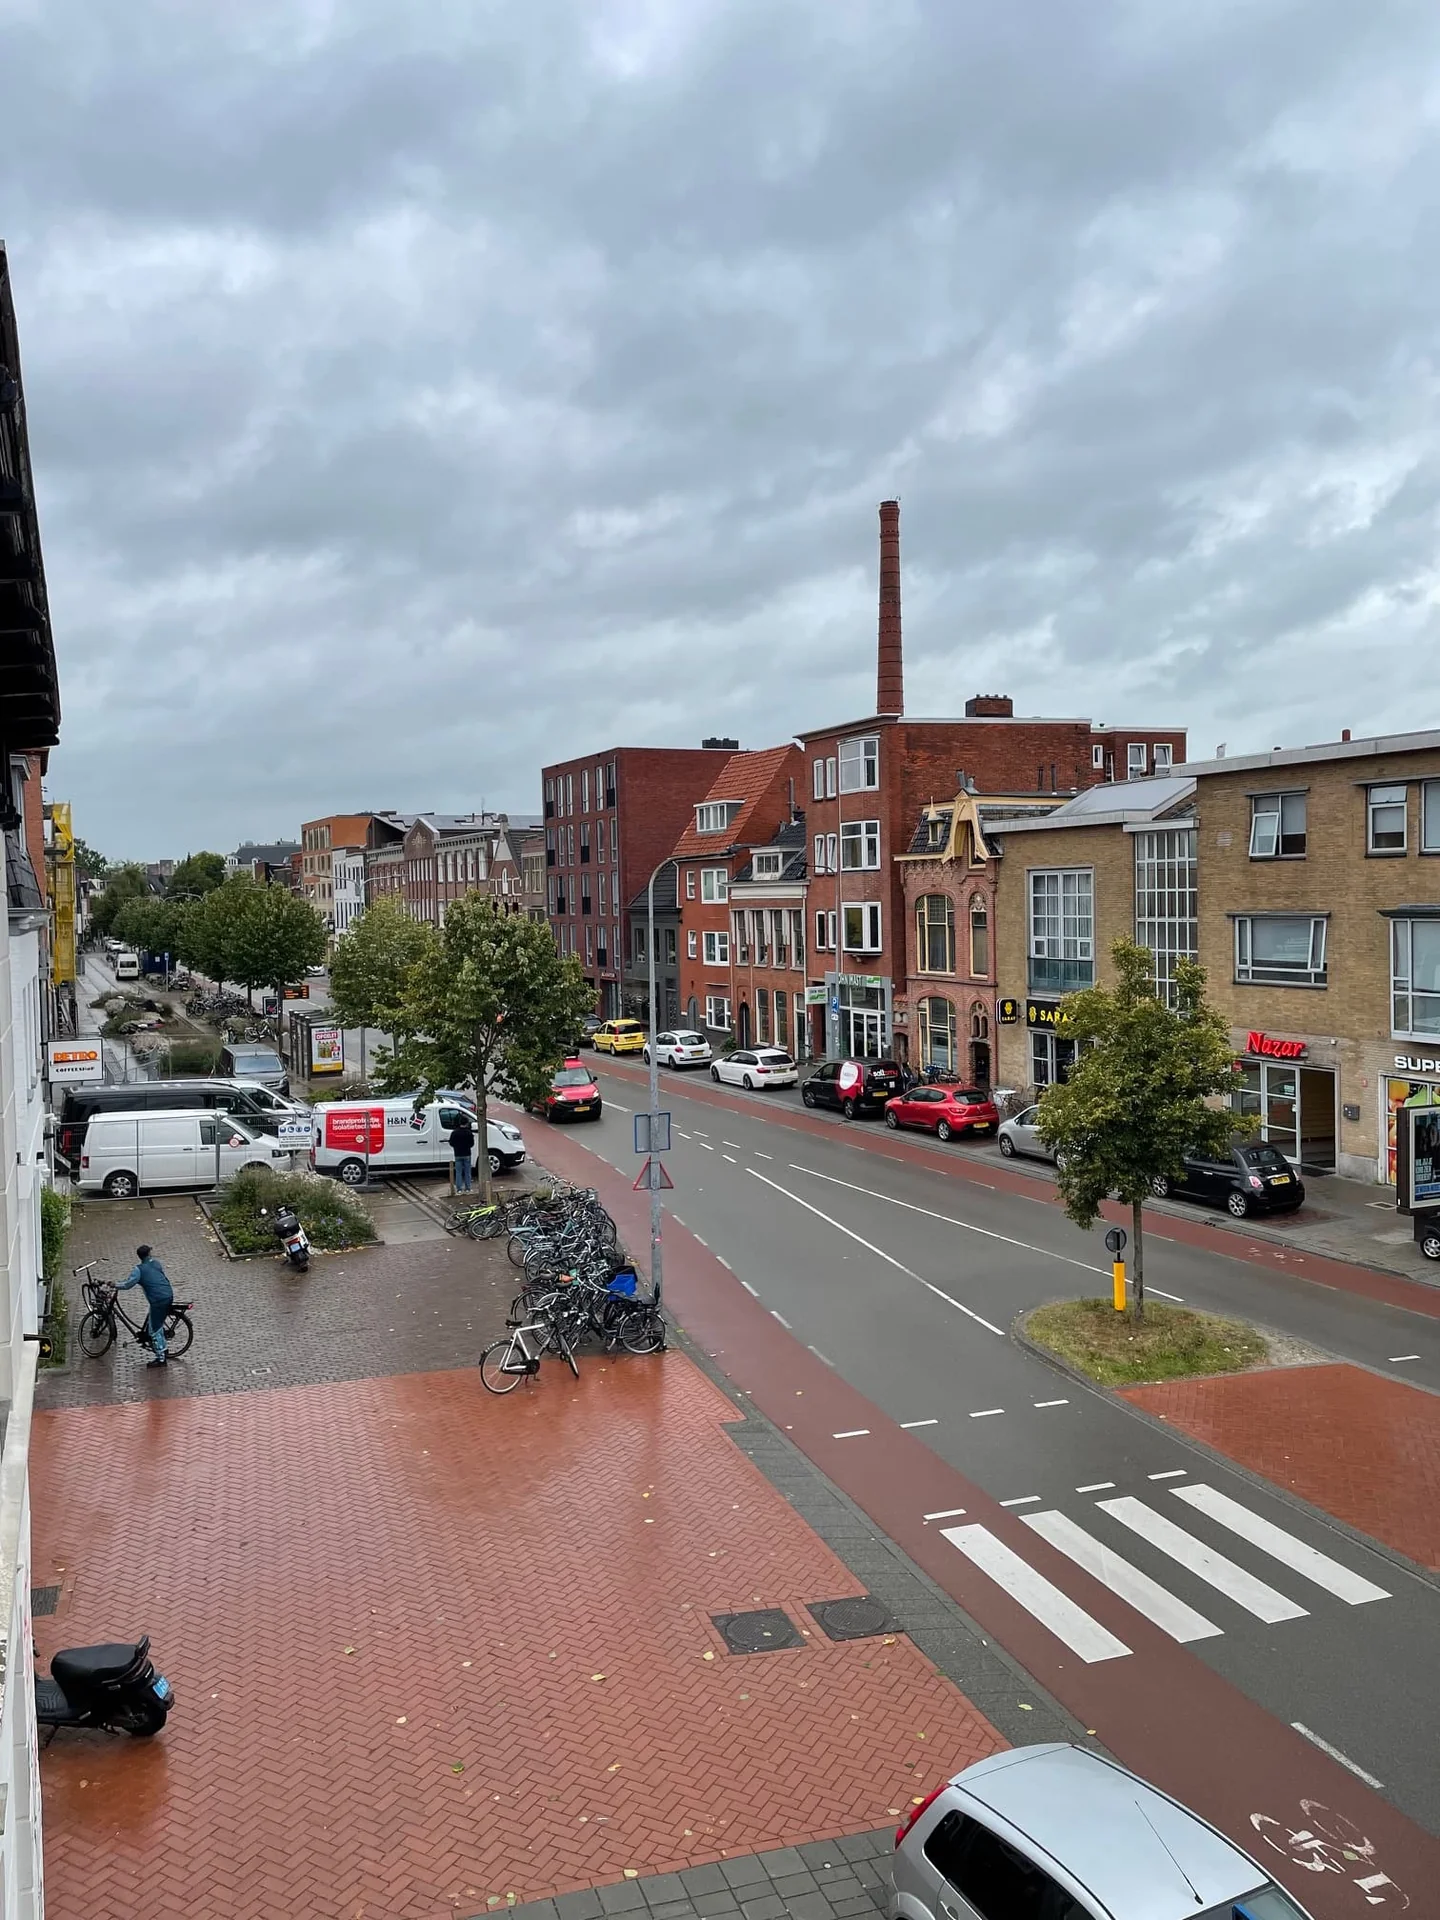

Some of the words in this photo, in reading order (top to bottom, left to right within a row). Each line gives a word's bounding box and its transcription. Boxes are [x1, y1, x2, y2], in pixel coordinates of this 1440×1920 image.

[1040, 1010, 1069, 1023] SARA
[1245, 1031, 1306, 1058] Nazar
[53, 1051, 98, 1063] RETRO
[332, 1117, 380, 1126] brandprotetie
[387, 1117, 407, 1125] H&N
[332, 1122, 382, 1131] isolatietecniek
